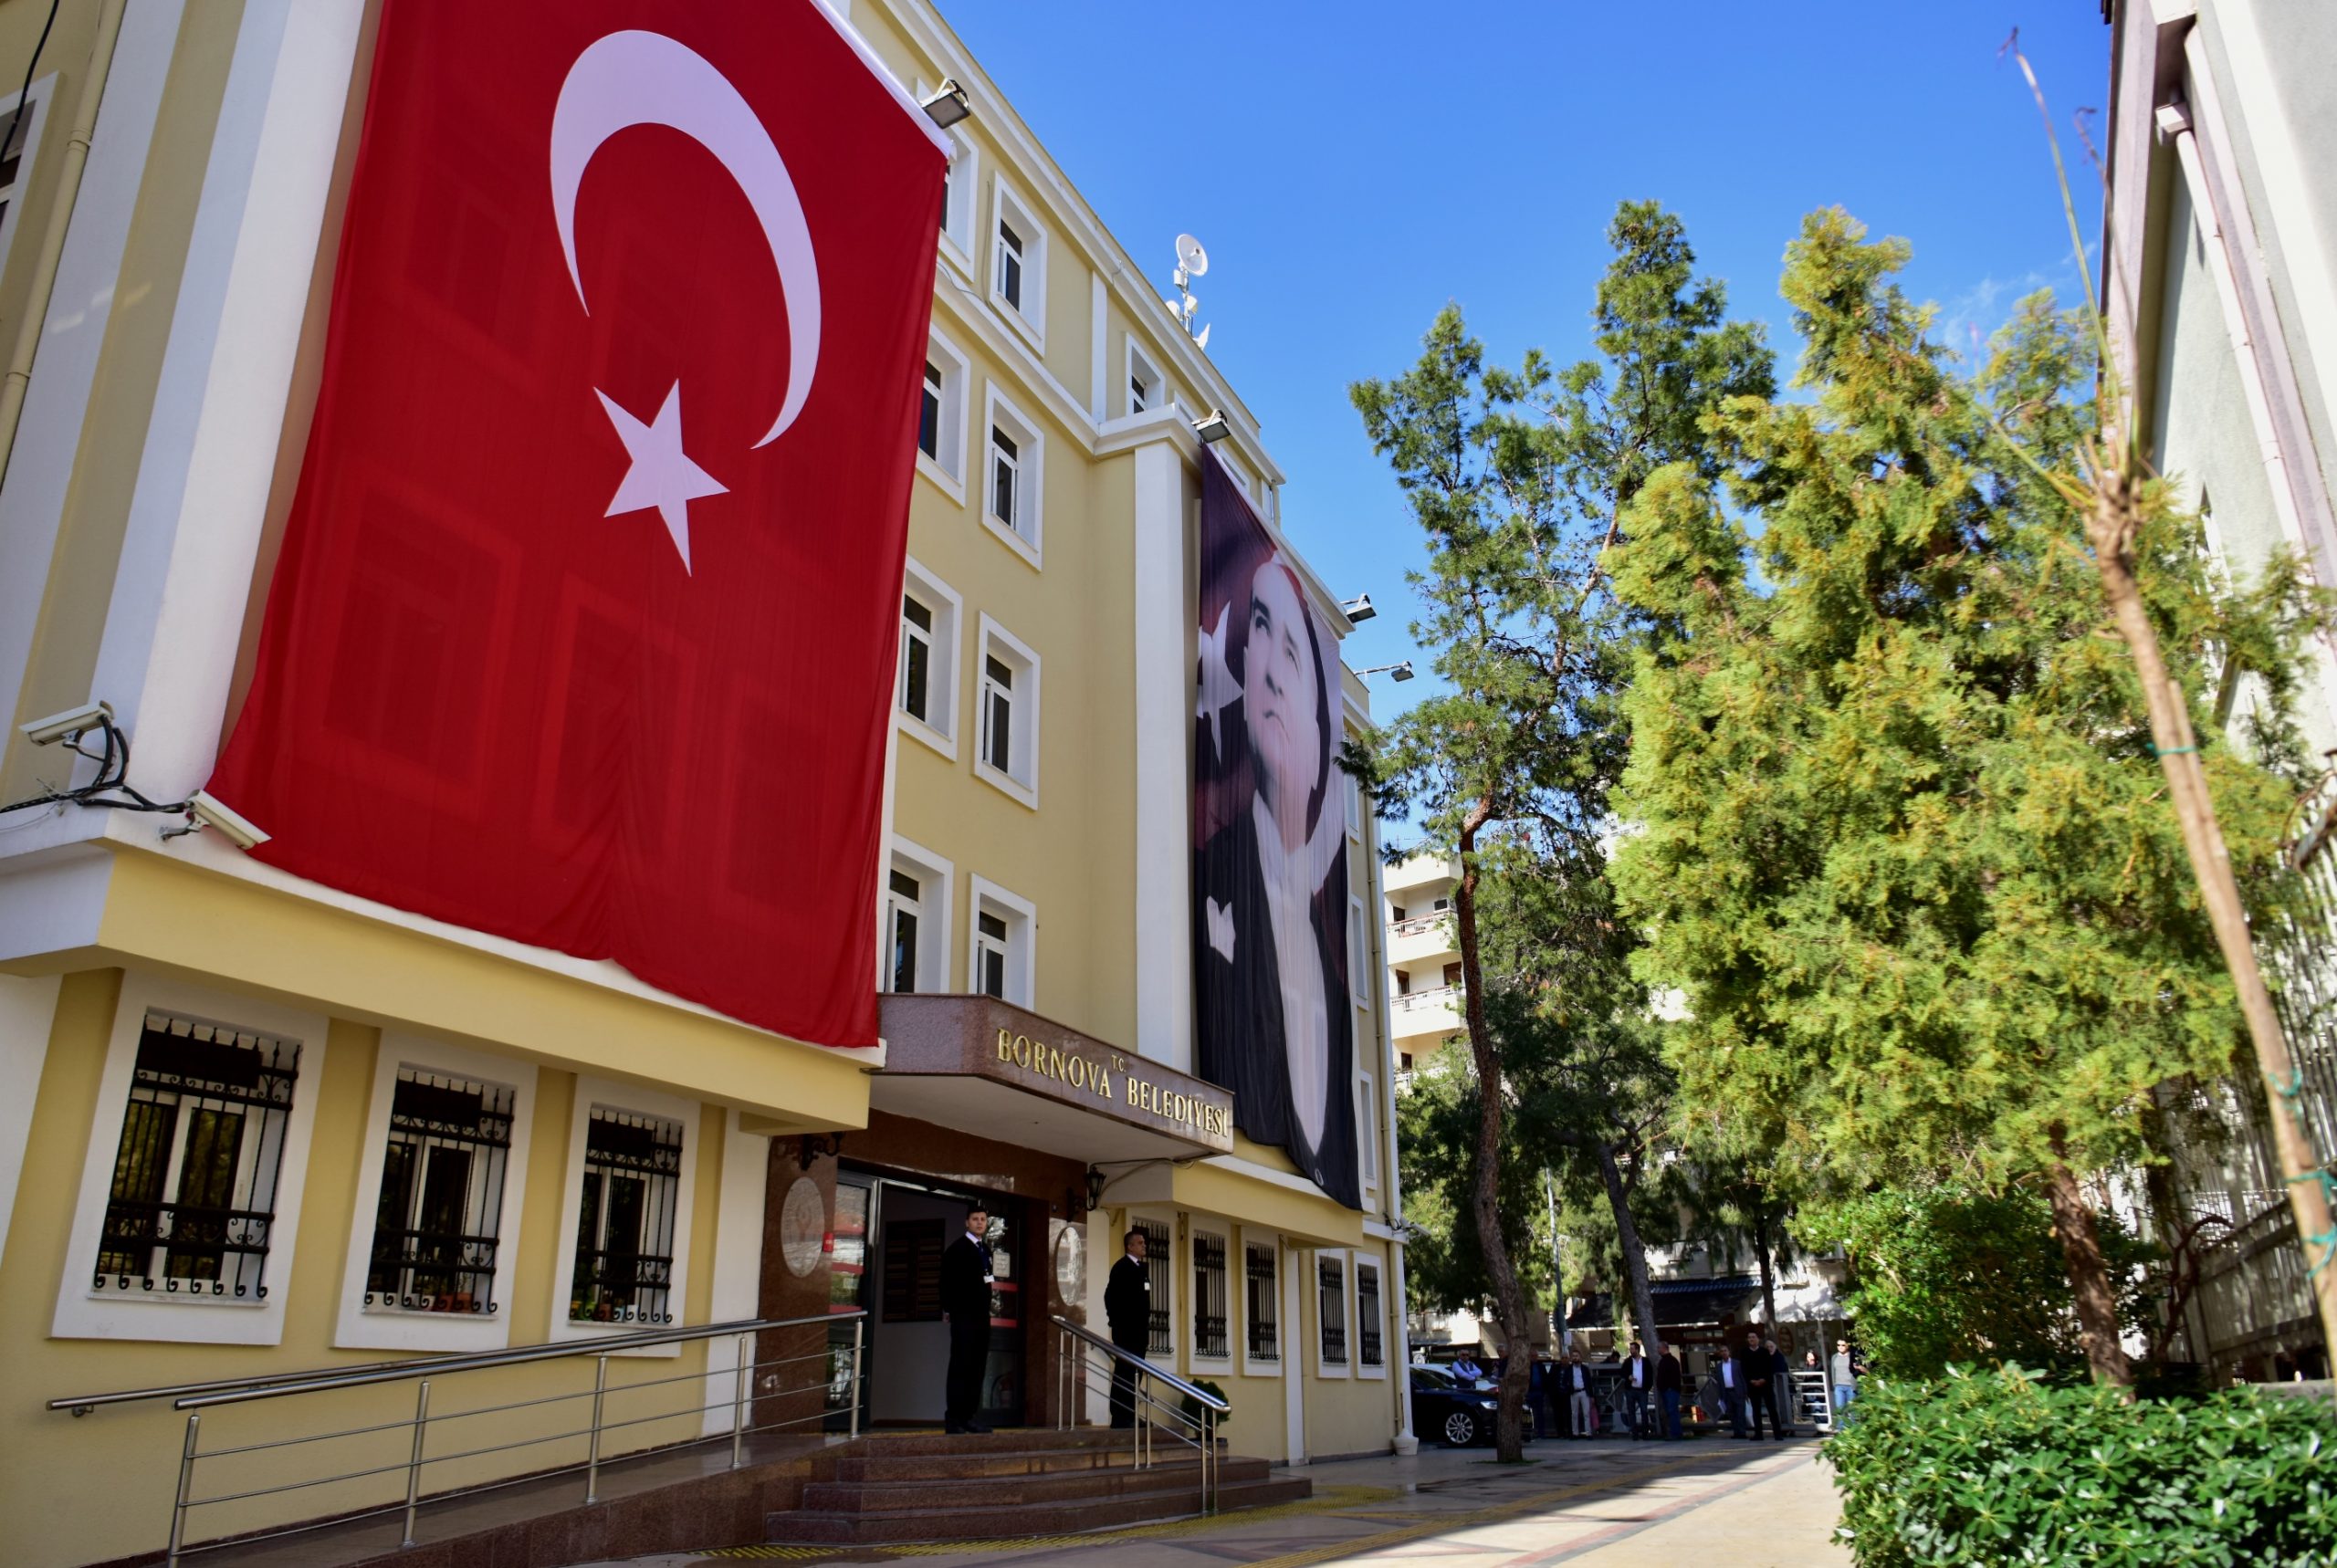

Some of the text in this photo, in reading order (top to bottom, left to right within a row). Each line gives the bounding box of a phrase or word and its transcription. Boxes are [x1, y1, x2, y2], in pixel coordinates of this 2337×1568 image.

[997, 1028, 1228, 1137] BORNOVA BELEDİYESİ
[1111, 1053, 1127, 1072] T.C.
